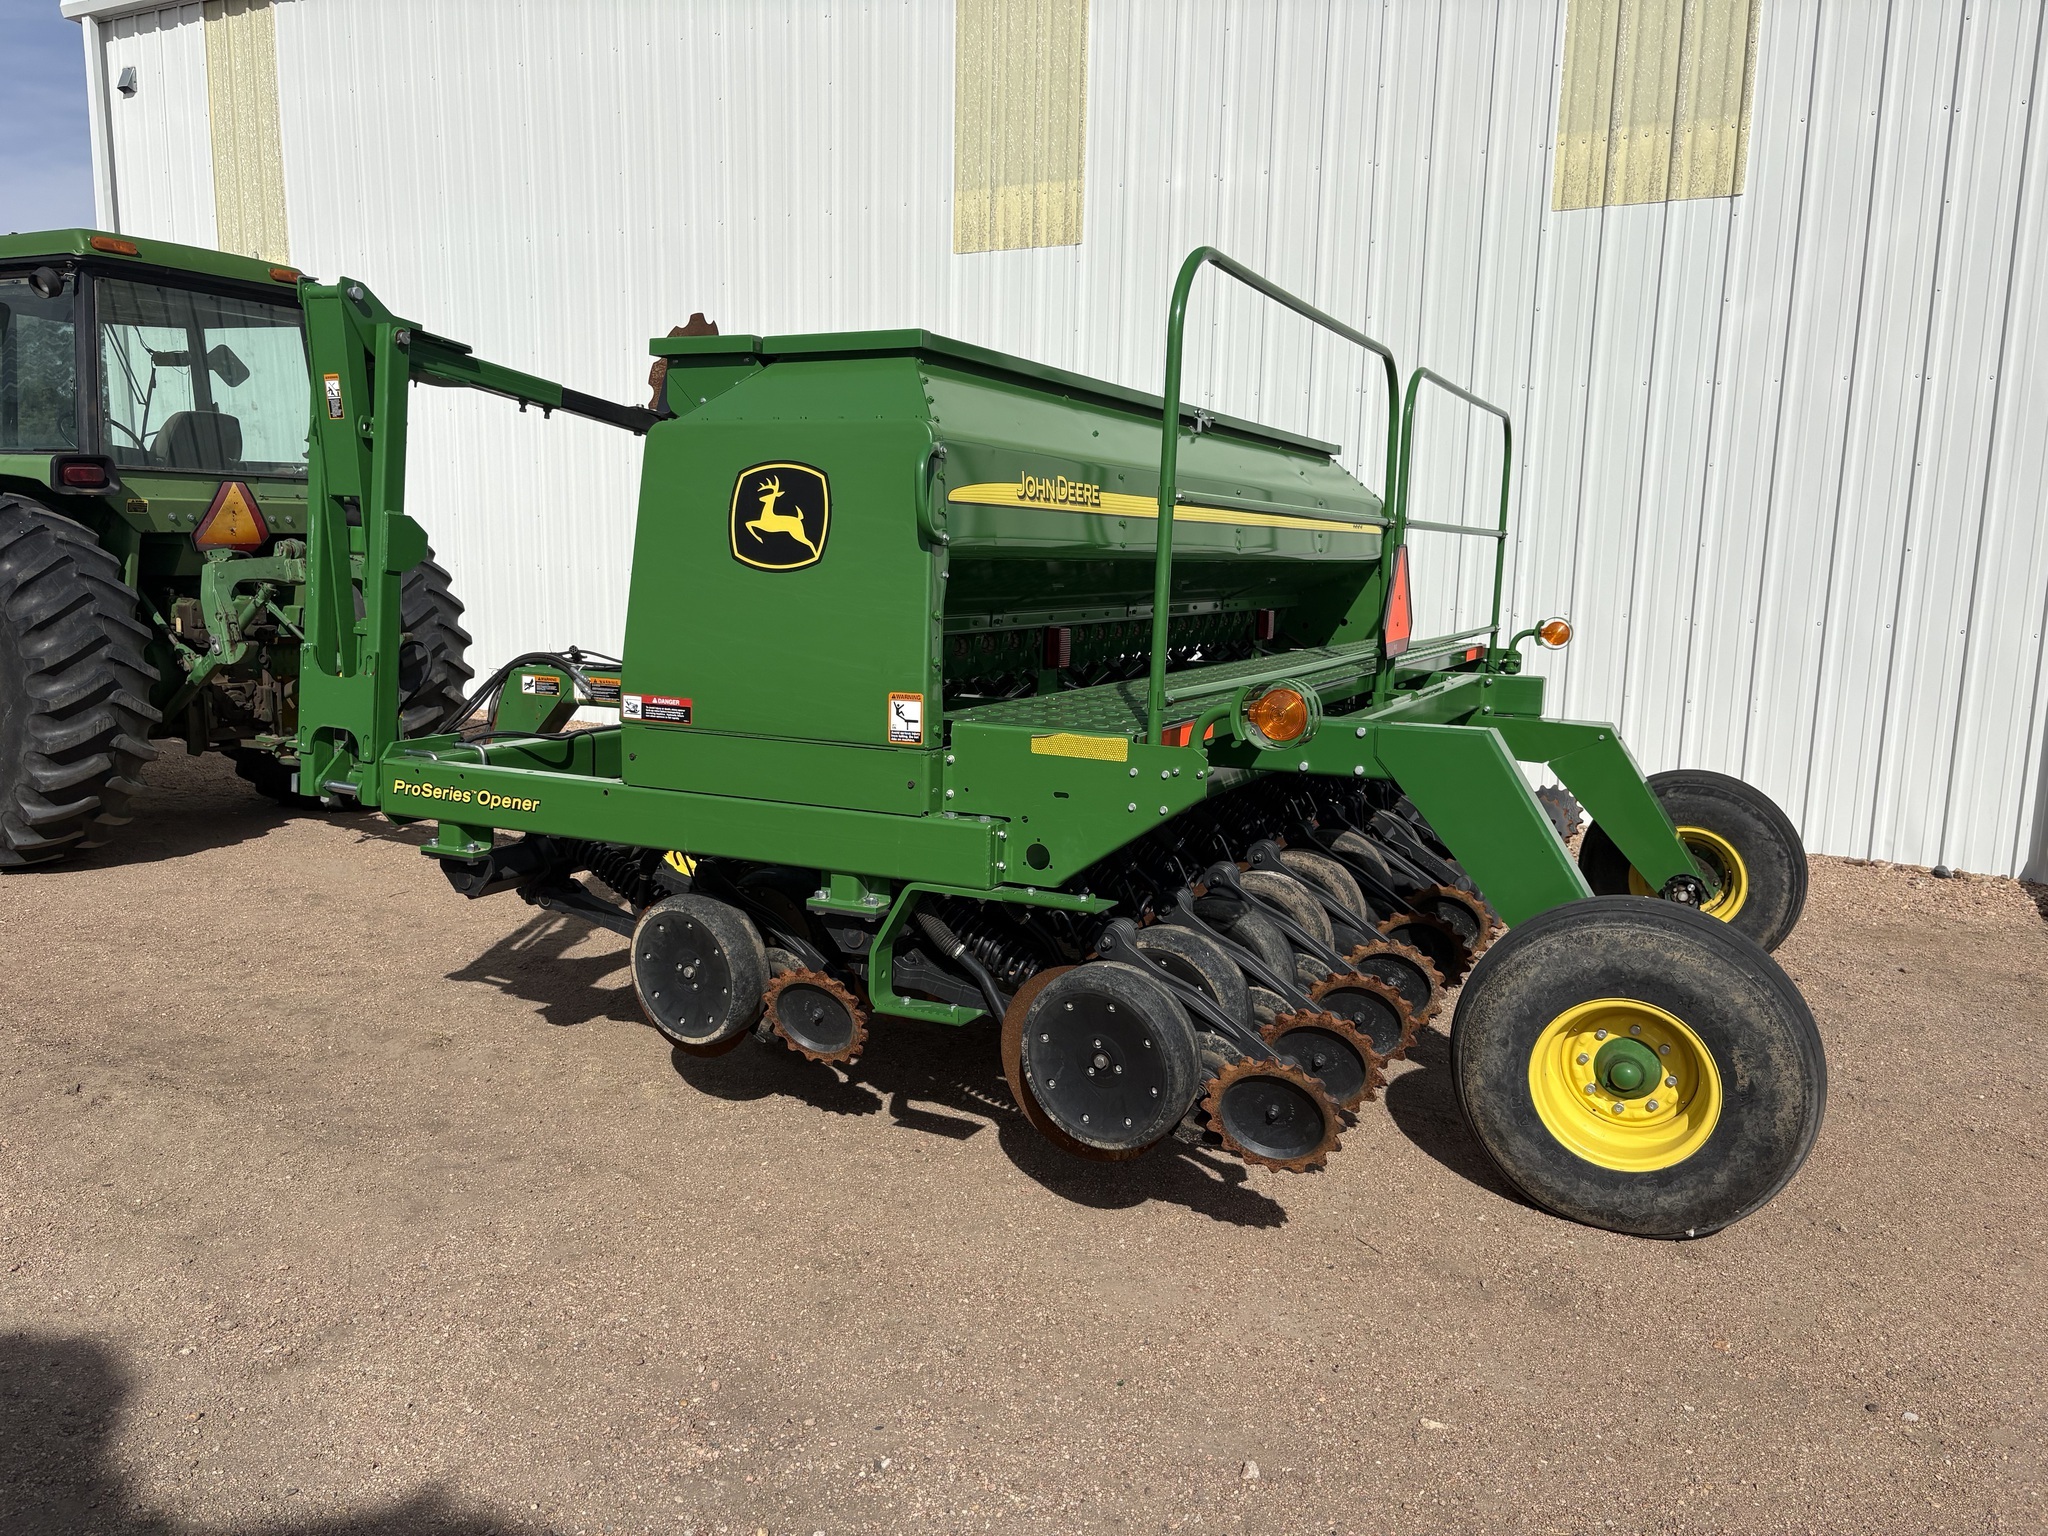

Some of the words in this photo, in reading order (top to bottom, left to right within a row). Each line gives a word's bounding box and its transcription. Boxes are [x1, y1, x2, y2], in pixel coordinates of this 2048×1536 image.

[1017, 470, 1056, 502] JOHN
[1056, 475, 1101, 507] DEERE
[657, 698, 680, 706] DANGER
[477, 789, 541, 812] Opener
